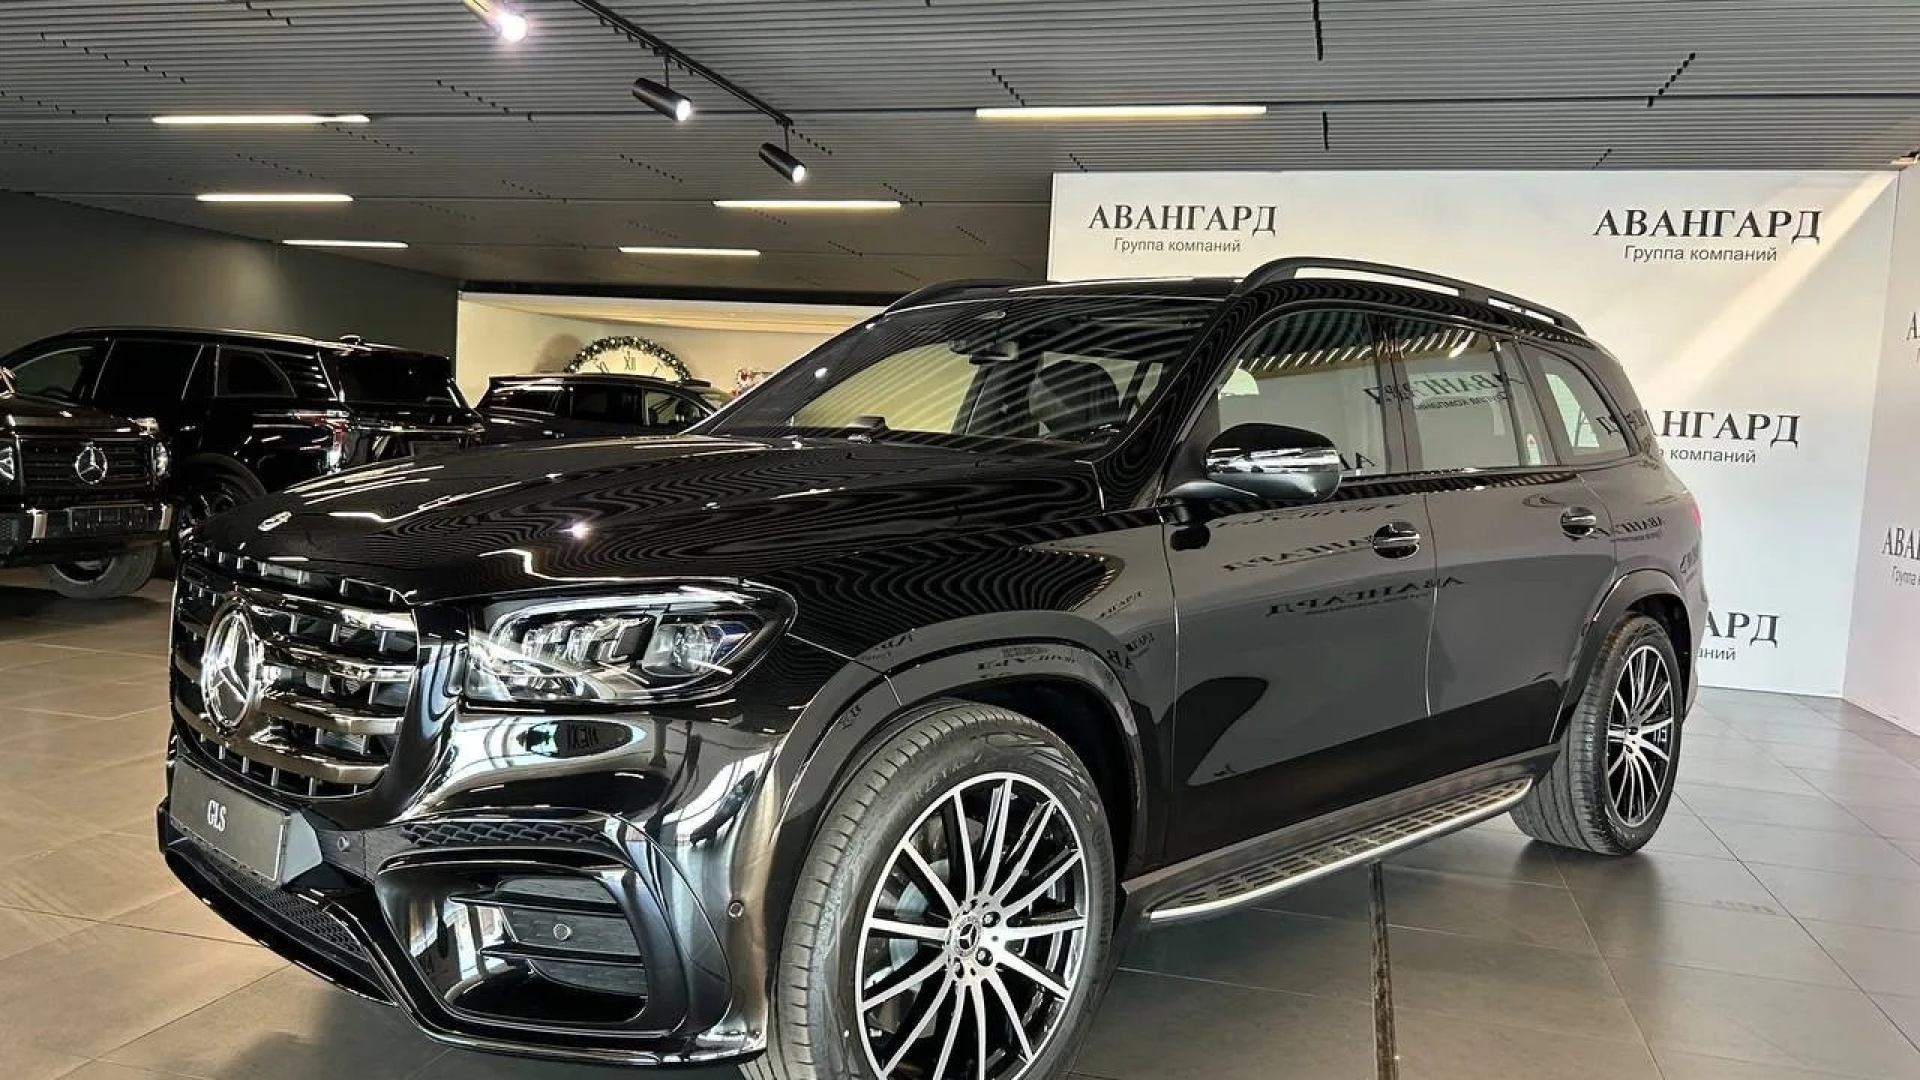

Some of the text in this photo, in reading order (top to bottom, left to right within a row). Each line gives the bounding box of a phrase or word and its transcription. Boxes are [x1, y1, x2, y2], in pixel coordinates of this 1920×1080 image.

[1088, 204, 1277, 236] АВАНГАРД
[1593, 209, 1823, 244] АВАНГАРД
[1114, 237, 1241, 252] Группа компаний
[1624, 245, 1777, 262] Группа компаний
[1670, 448, 1756, 463] компаний
[1881, 527, 1920, 560] АВА
[207, 800, 228, 832] GLS
